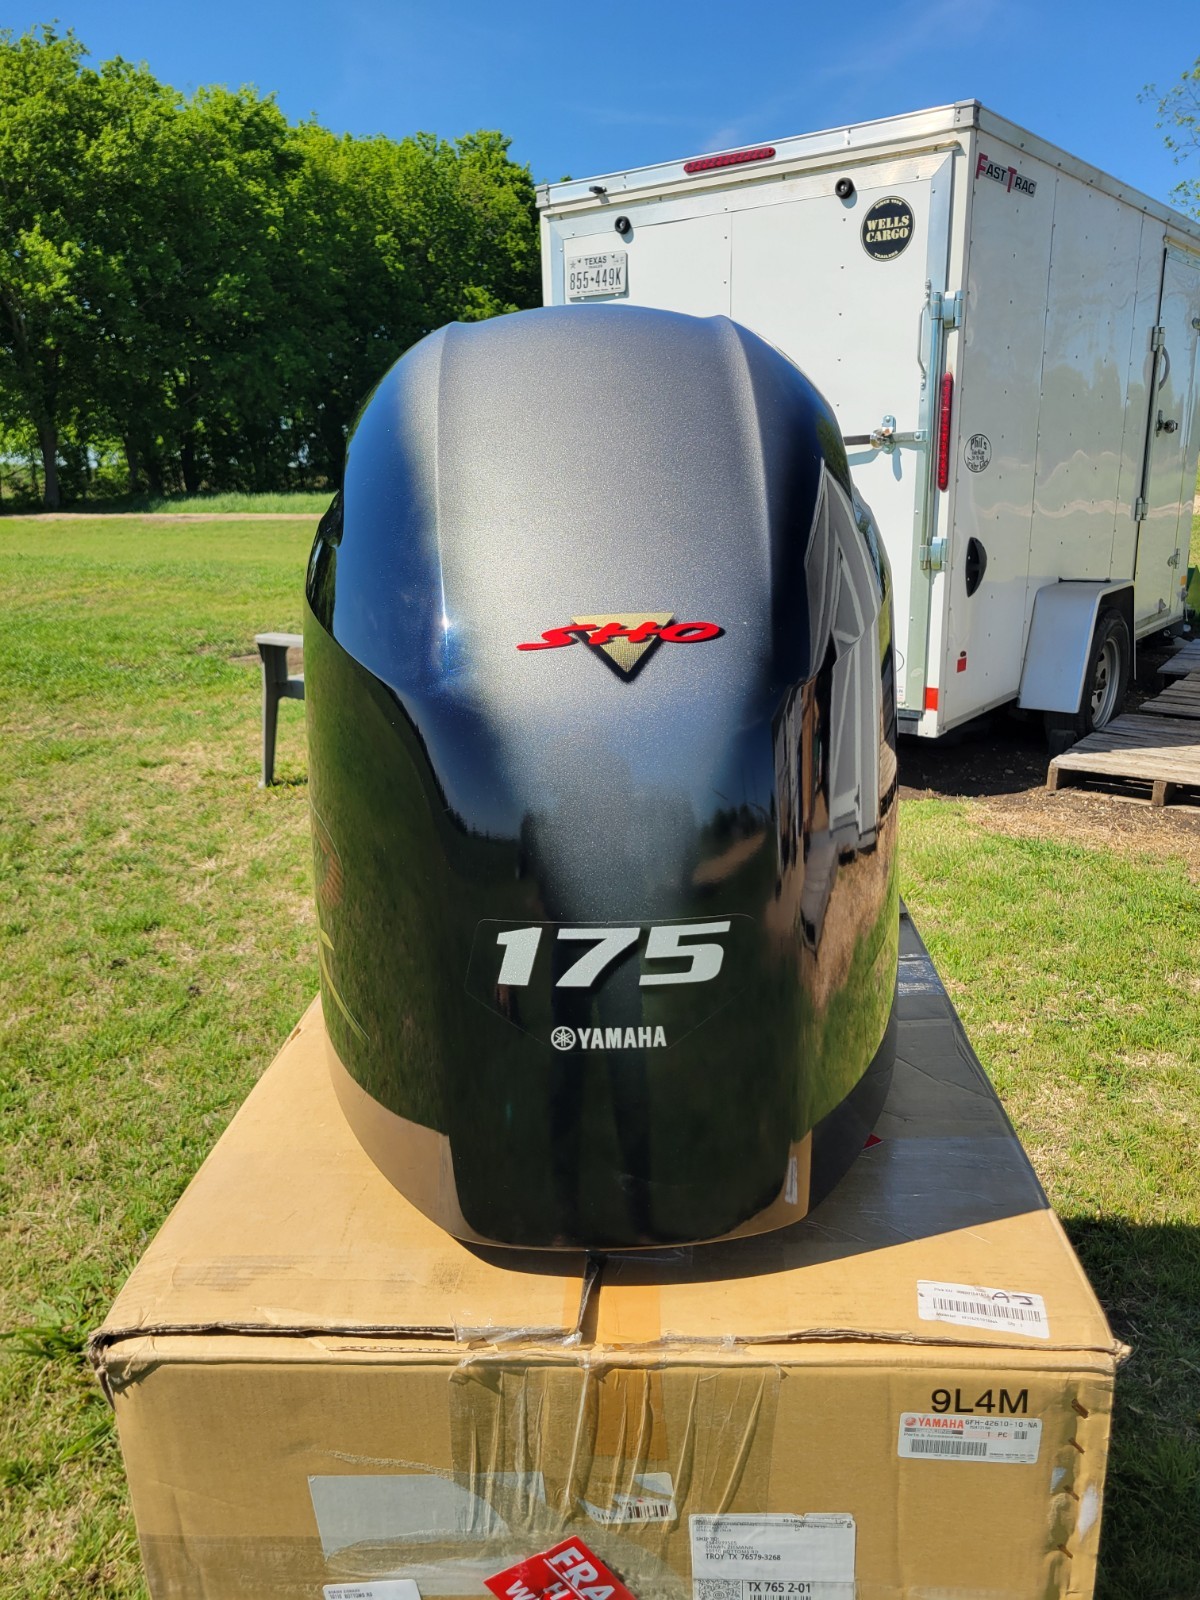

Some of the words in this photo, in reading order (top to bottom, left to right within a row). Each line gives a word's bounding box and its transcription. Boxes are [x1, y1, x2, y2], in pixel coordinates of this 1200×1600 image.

[866, 215, 910, 231] WELLS
[865, 227, 909, 243] CARGO
[584, 255, 607, 266] TEXAS
[516, 621, 722, 651] SHO
[496, 920, 731, 987] 175
[577, 1026, 667, 1049] YAMAHA
[931, 1388, 1029, 1414] 9L4M
[918, 1417, 964, 1429] YAMAHA
[705, 1553, 725, 1561] TROY
[729, 1553, 738, 1561] TX
[741, 1553, 781, 1561] 76579-3268
[747, 1581, 762, 1593] TX
[764, 1582, 785, 1593] 765
[787, 1582, 811, 1593] 2-01
